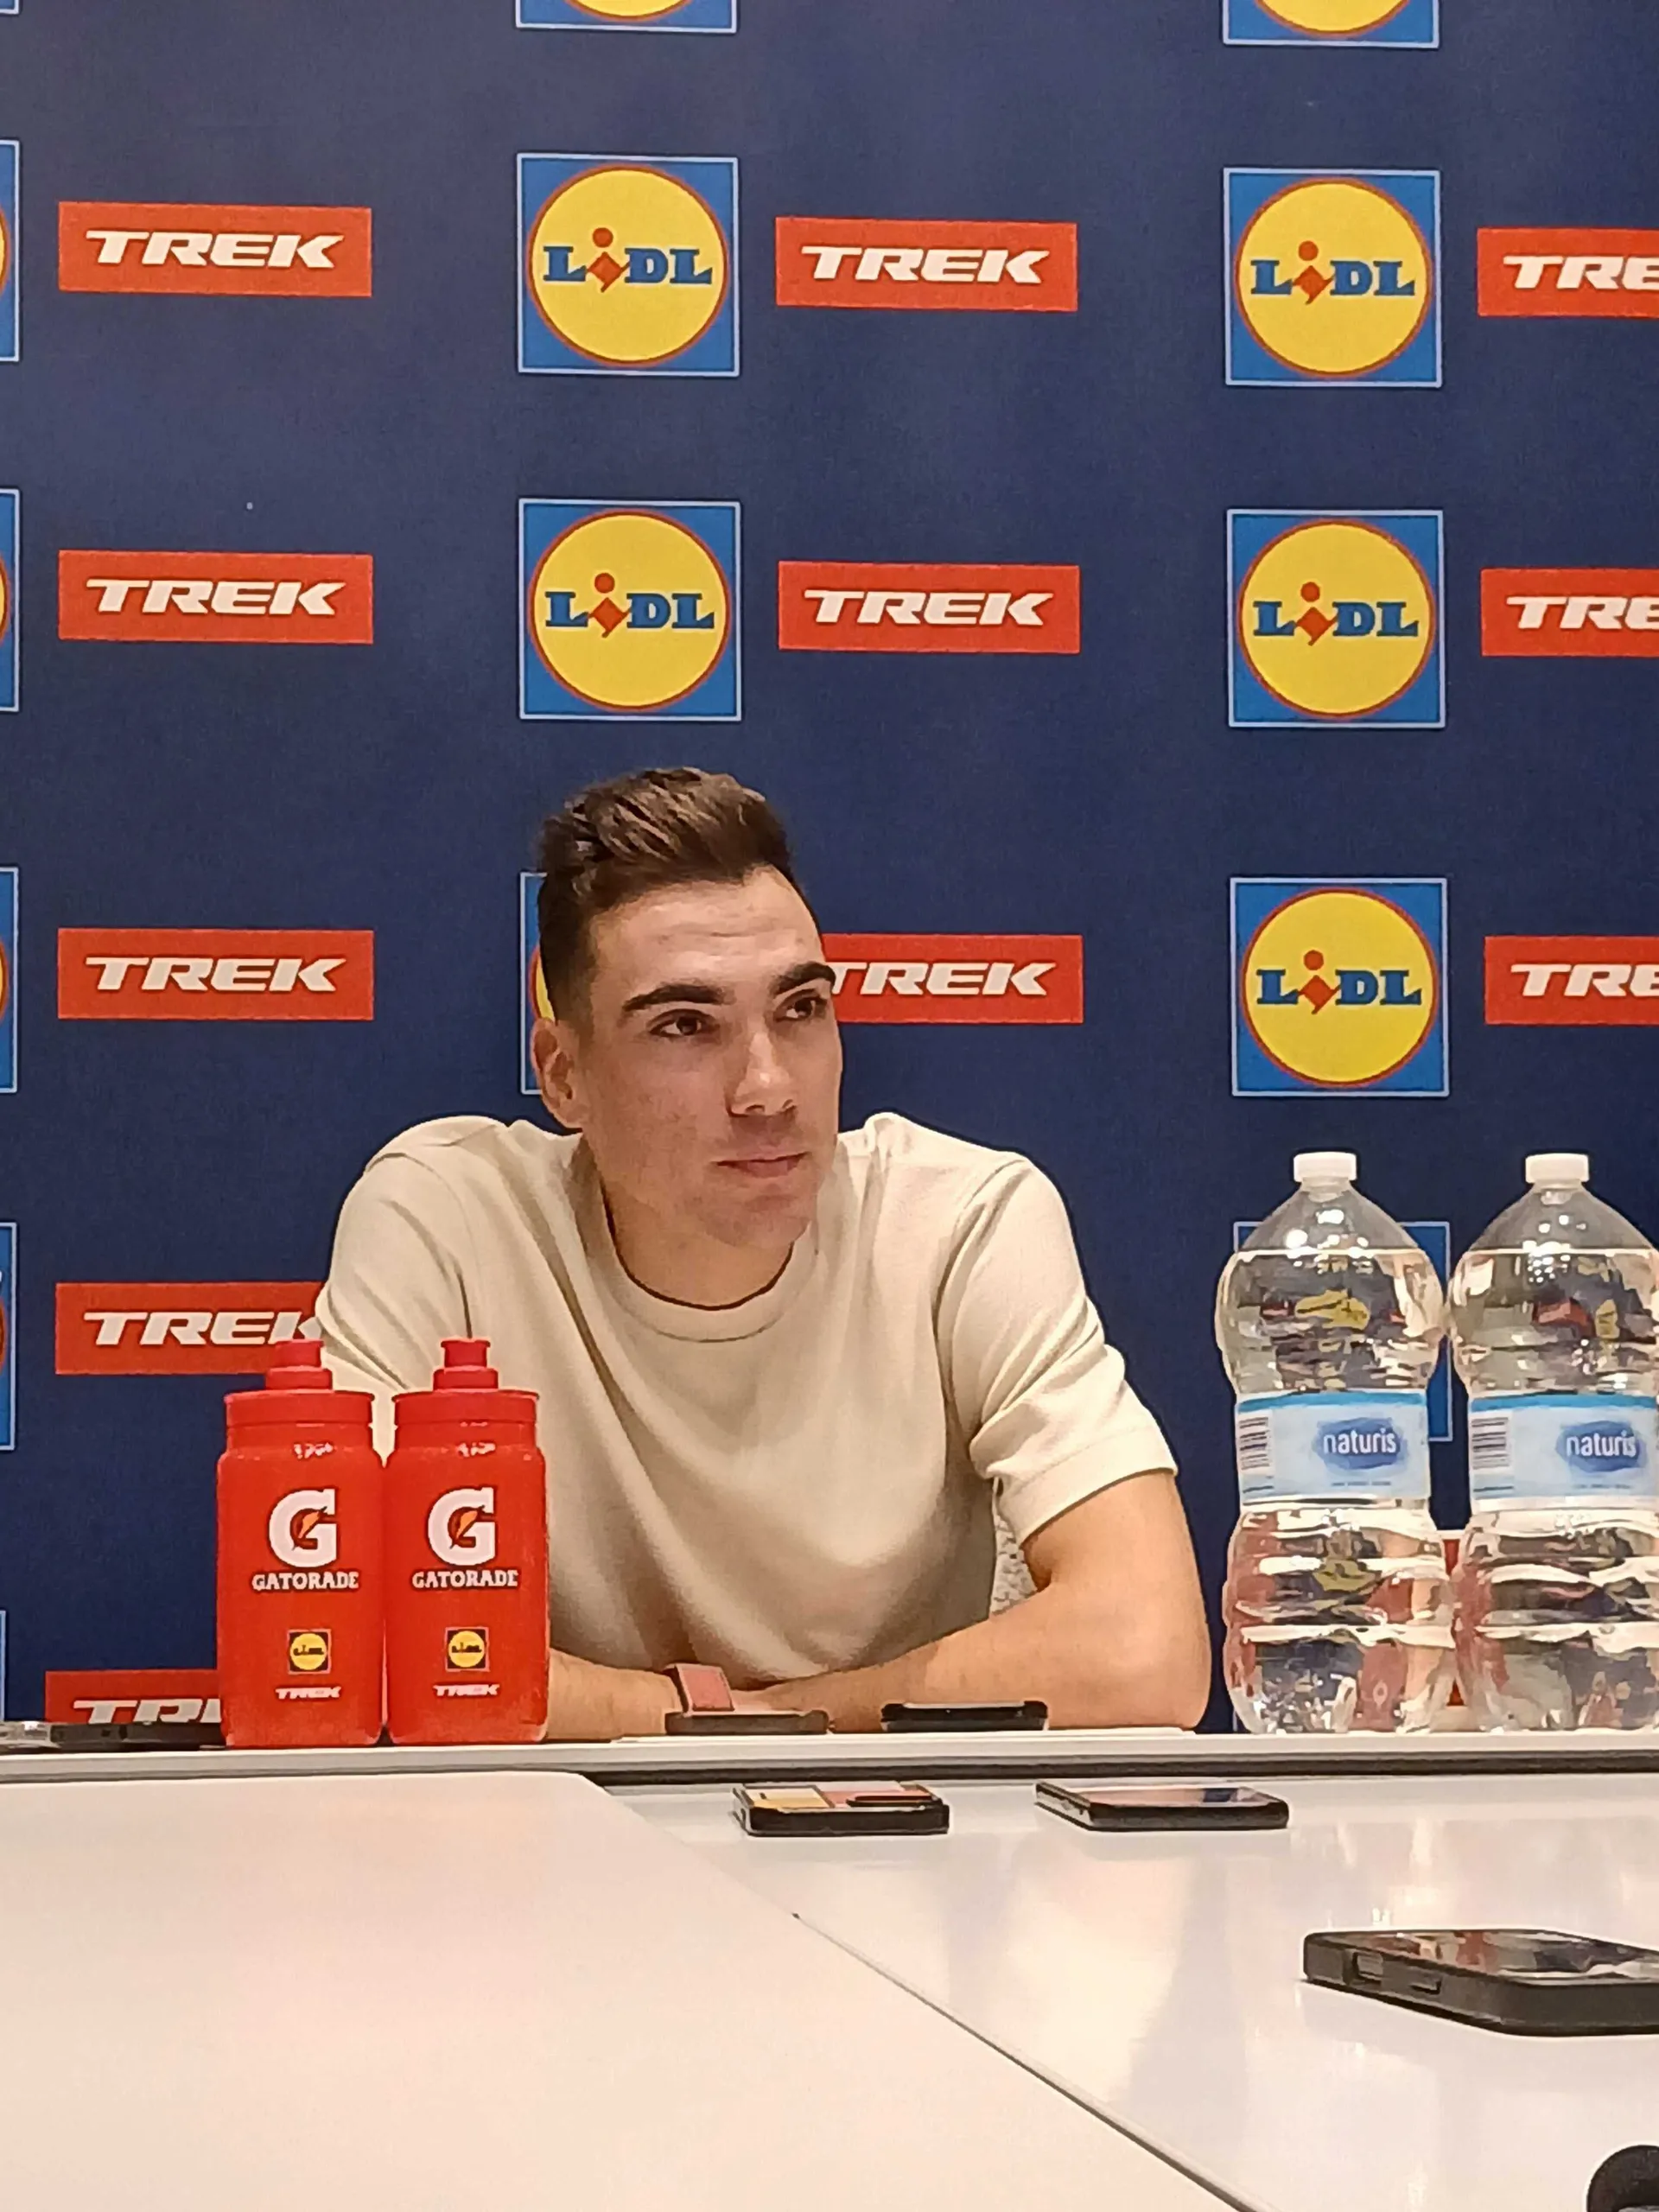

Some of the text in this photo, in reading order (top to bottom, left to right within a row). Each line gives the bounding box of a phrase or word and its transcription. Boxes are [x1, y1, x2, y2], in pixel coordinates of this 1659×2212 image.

[86, 231, 344, 270] TREK
[802, 246, 1050, 283] TREK
[1503, 256, 1659, 290] TRE
[87, 580, 345, 615] TREK
[804, 590, 1053, 626] TREK
[1506, 596, 1659, 629] TRE
[86, 957, 346, 992] TREK
[1510, 964, 1659, 996] TRE
[1323, 1427, 1396, 1454] naturis
[1566, 1429, 1637, 1458] naturis
[270, 1489, 337, 1567] G
[428, 1487, 496, 1566] G
[251, 1572, 359, 1591] GATORADE
[412, 1570, 518, 1589] GATORADE
